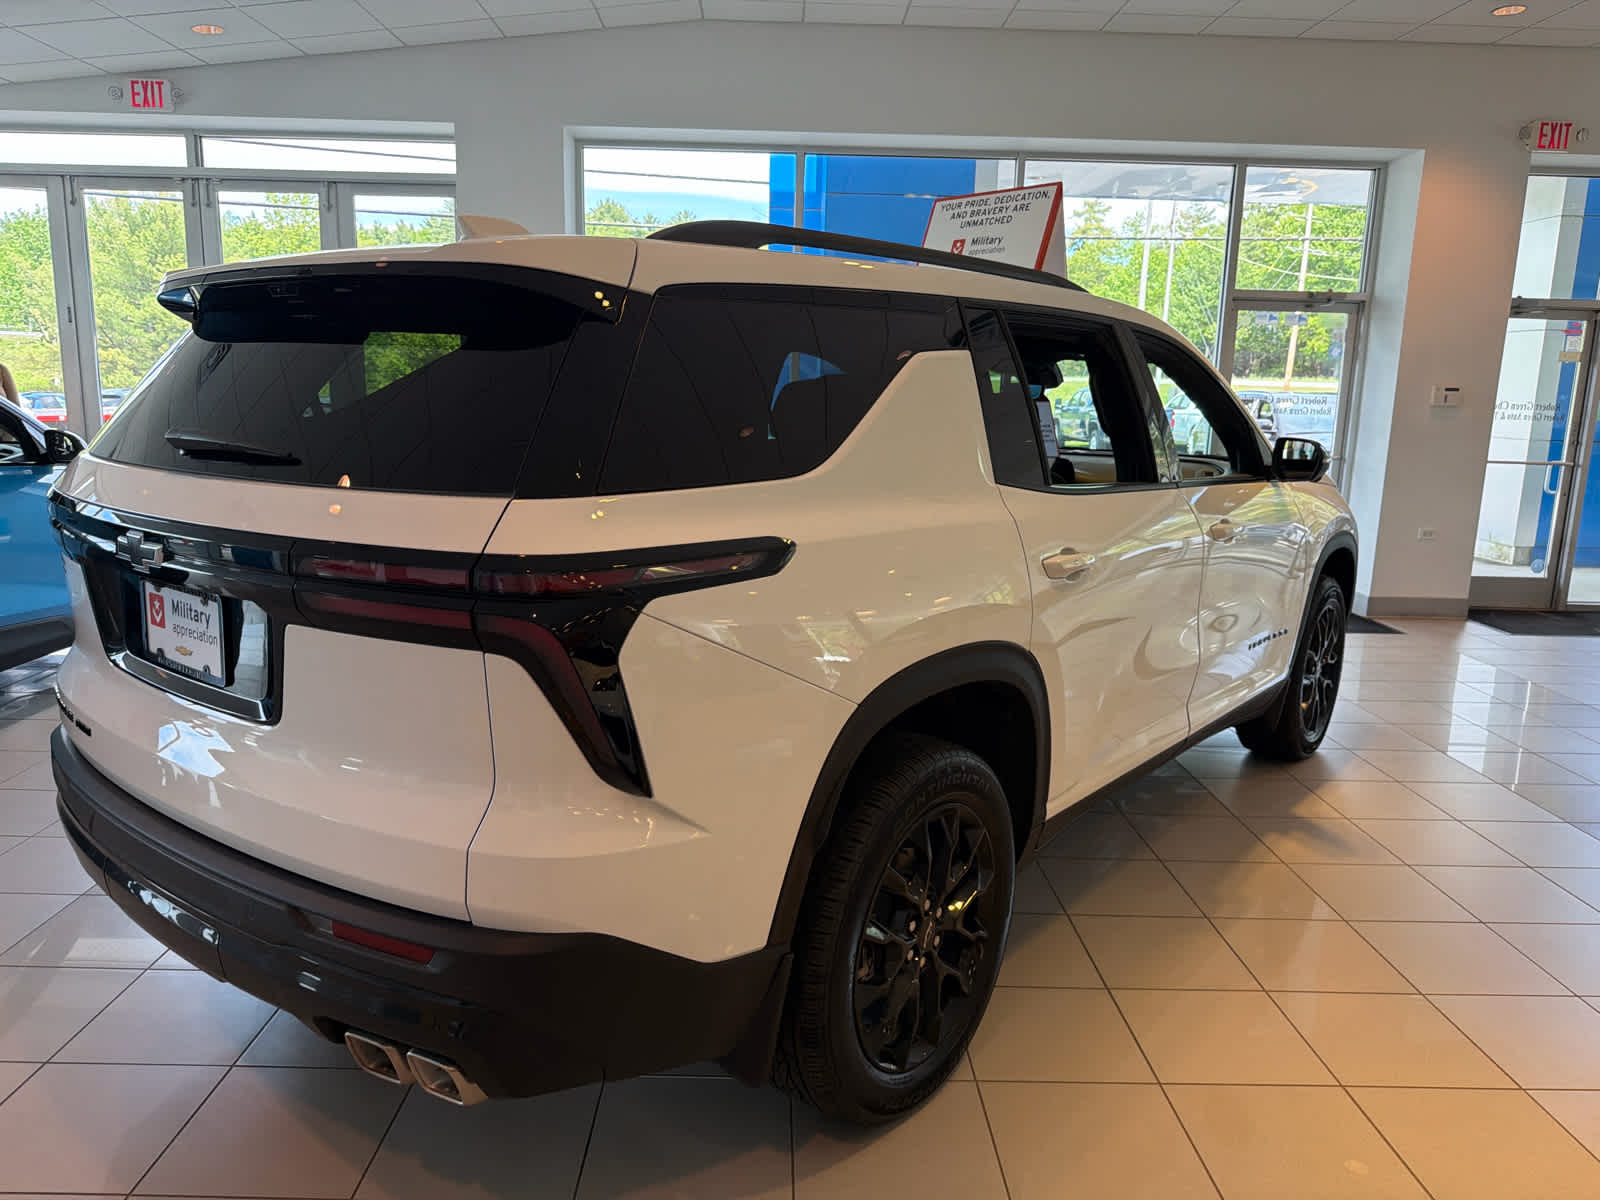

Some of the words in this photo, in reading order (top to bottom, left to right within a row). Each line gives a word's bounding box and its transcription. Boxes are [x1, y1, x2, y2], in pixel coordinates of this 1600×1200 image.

[130, 79, 164, 108] EXIT
[1537, 122, 1573, 150] EXIT
[941, 202, 962, 212] YOUR
[964, 198, 992, 210] PRIDE,
[950, 211, 968, 221] AND
[969, 206, 1009, 218] BRAVERY
[1012, 202, 1031, 212] ARE
[960, 215, 1013, 229] UNMATCHED
[970, 236, 1003, 247] Military
[171, 599, 211, 629] Military
[172, 623, 218, 647] appreciation
